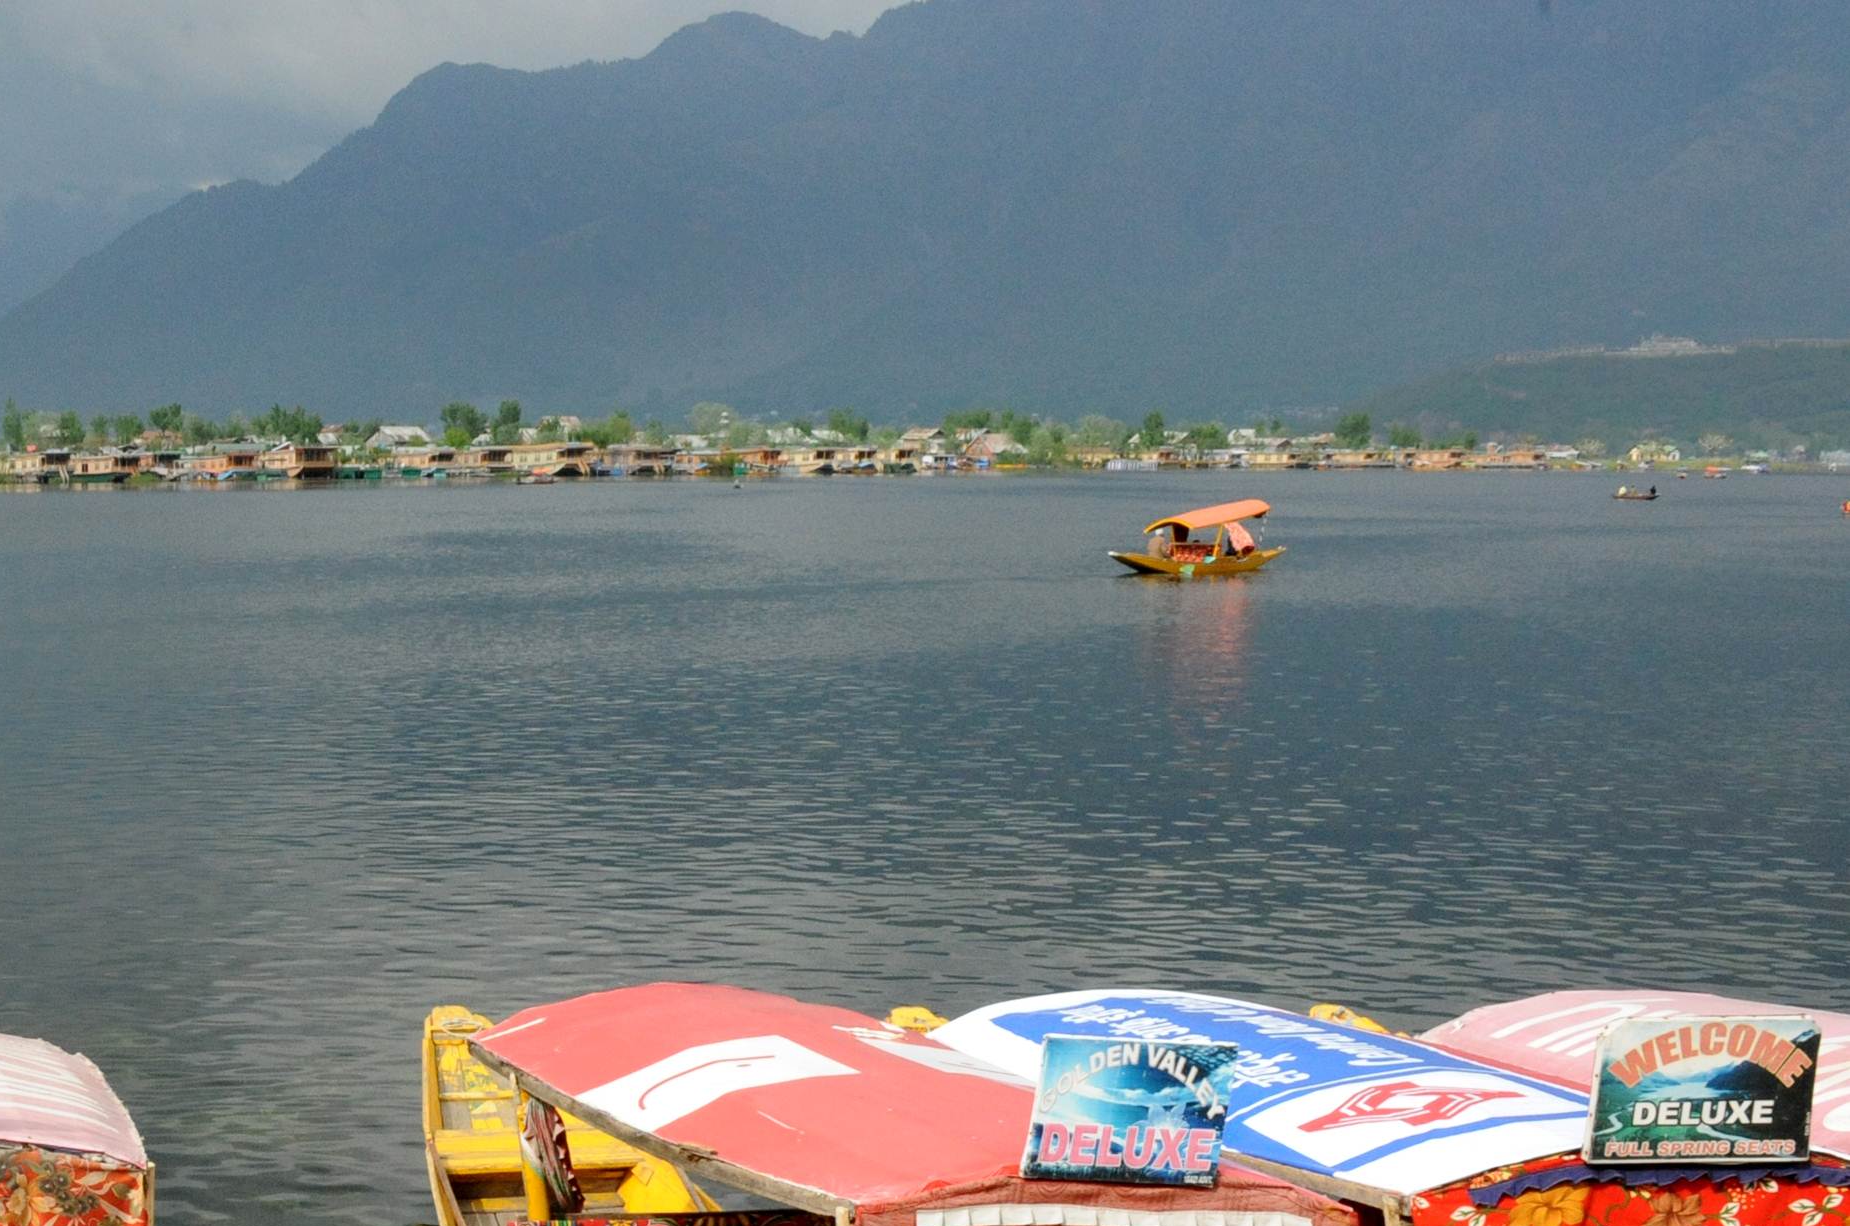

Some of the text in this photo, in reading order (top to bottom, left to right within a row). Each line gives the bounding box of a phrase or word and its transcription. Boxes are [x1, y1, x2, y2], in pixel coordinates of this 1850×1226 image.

[1609, 1022, 1813, 1089] WELCOME
[1147, 1042, 1226, 1120] VALLEY
[1632, 1100, 1775, 1126] DELUXE
[1037, 1122, 1218, 1172] DELUXE
[1605, 1139, 1796, 1157] FULL SPRING SEATS
